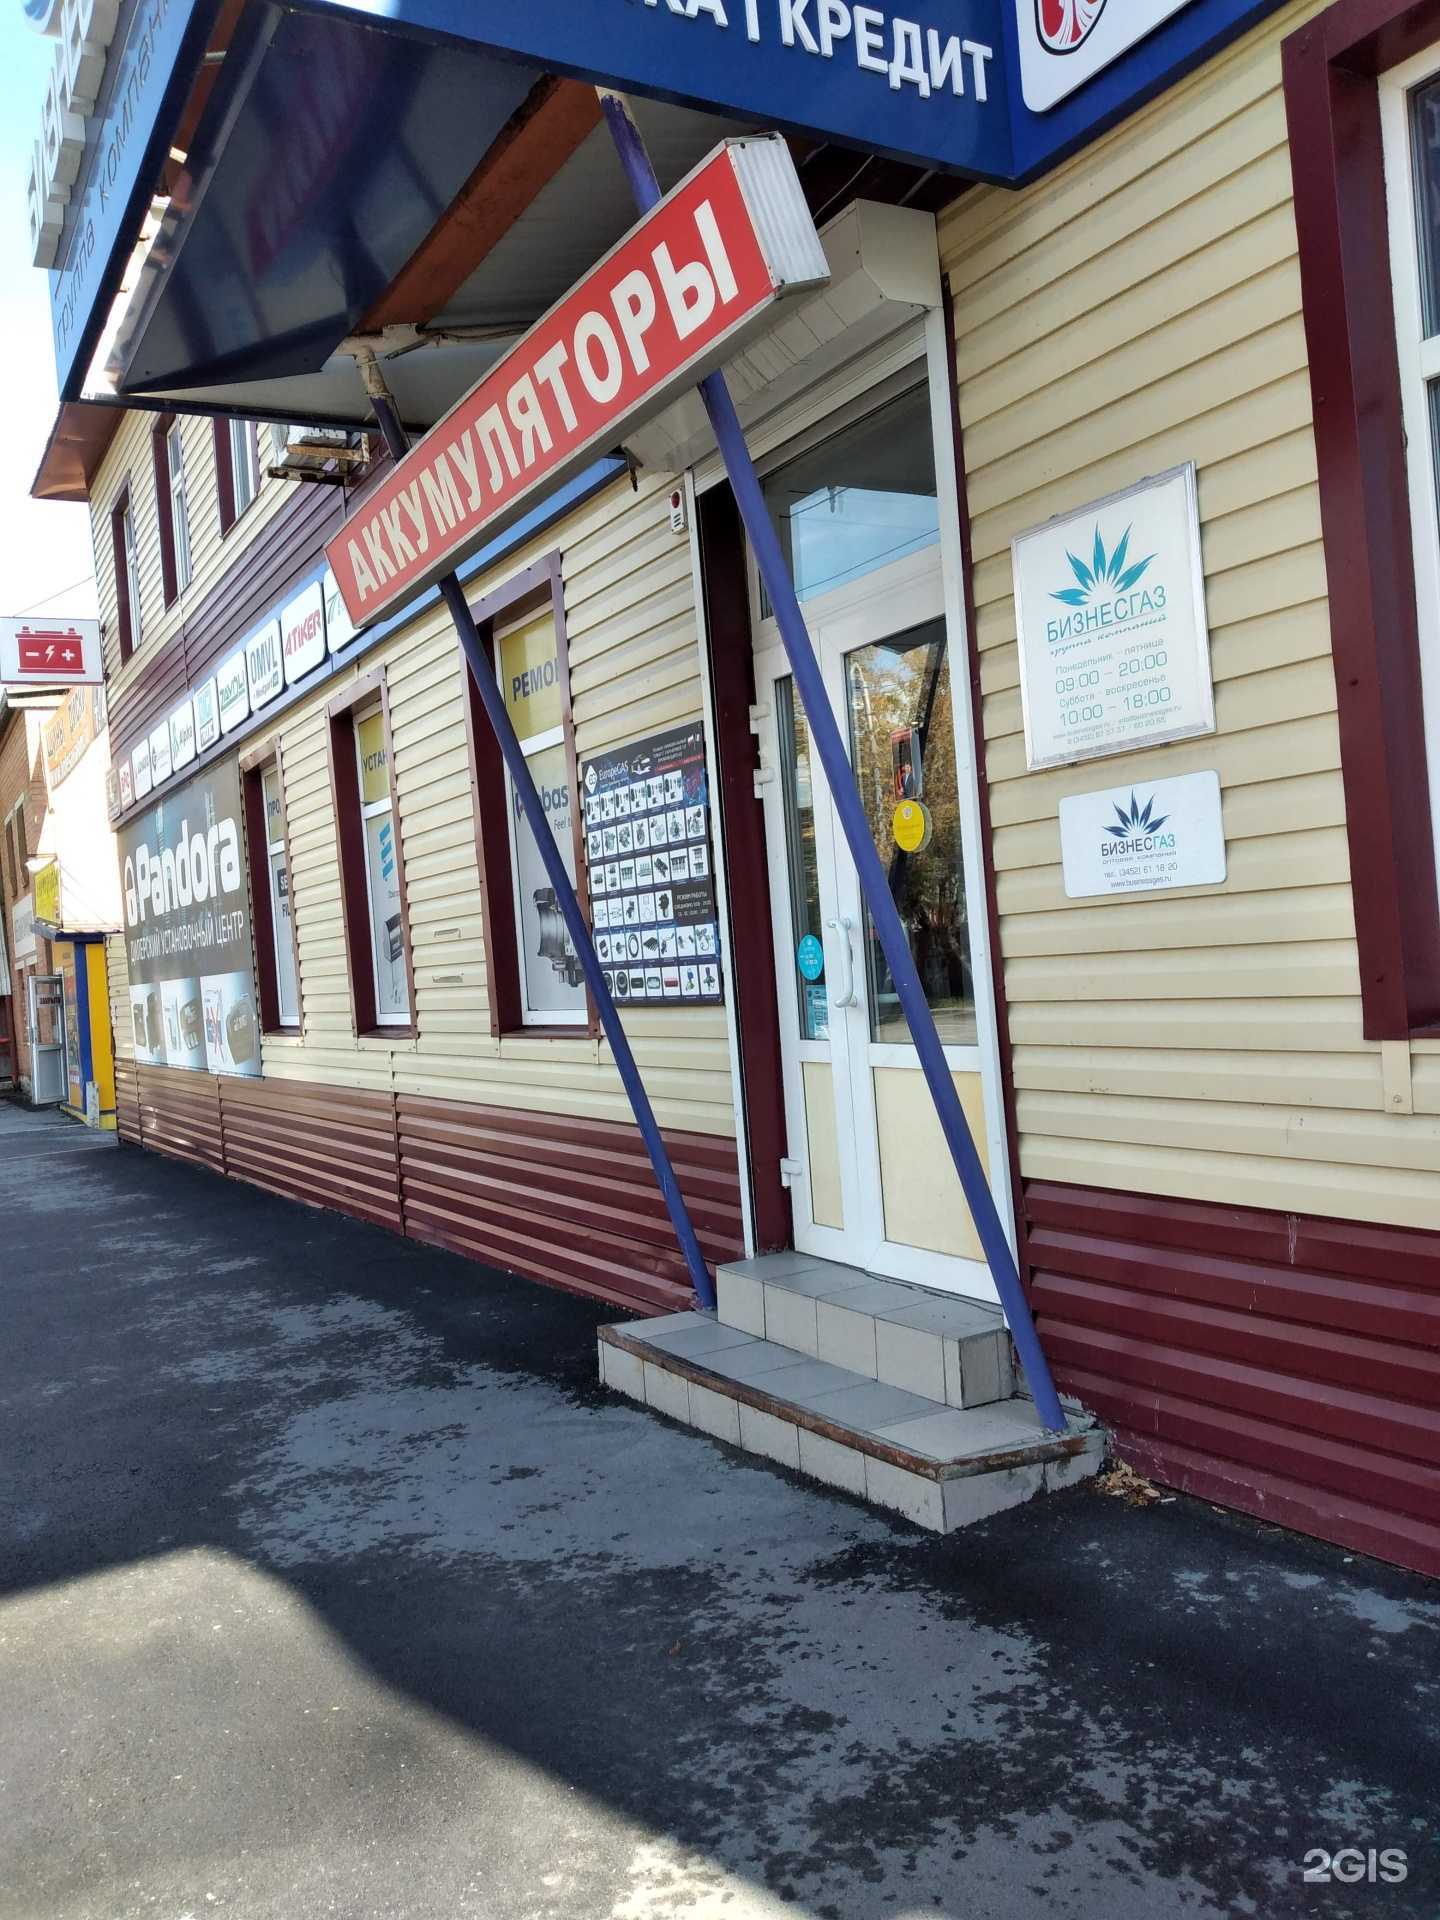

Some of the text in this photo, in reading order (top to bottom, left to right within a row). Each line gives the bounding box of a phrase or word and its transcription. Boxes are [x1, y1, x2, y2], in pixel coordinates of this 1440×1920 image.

[779, 0, 992, 102] КРЕДИТ
[347, 199, 739, 602] АККУМУЛЯТОРЫ
[285, 608, 322, 657] ATIKER
[1047, 585, 1167, 643] БИЗНЕСГАЗ
[250, 634, 278, 685] OMVL
[1055, 670, 1100, 694] 09:00
[1118, 651, 1168, 677] 20:00
[1059, 704, 1104, 726] 10:00
[1123, 686, 1172, 711] 18:00
[136, 817, 242, 922] Pandora
[1101, 834, 1176, 856] БИЗНЕСГАЗ
[160, 913, 215, 955] УСТАНОВОЧНЫЙ
[215, 910, 244, 950] ЦЕНТР
